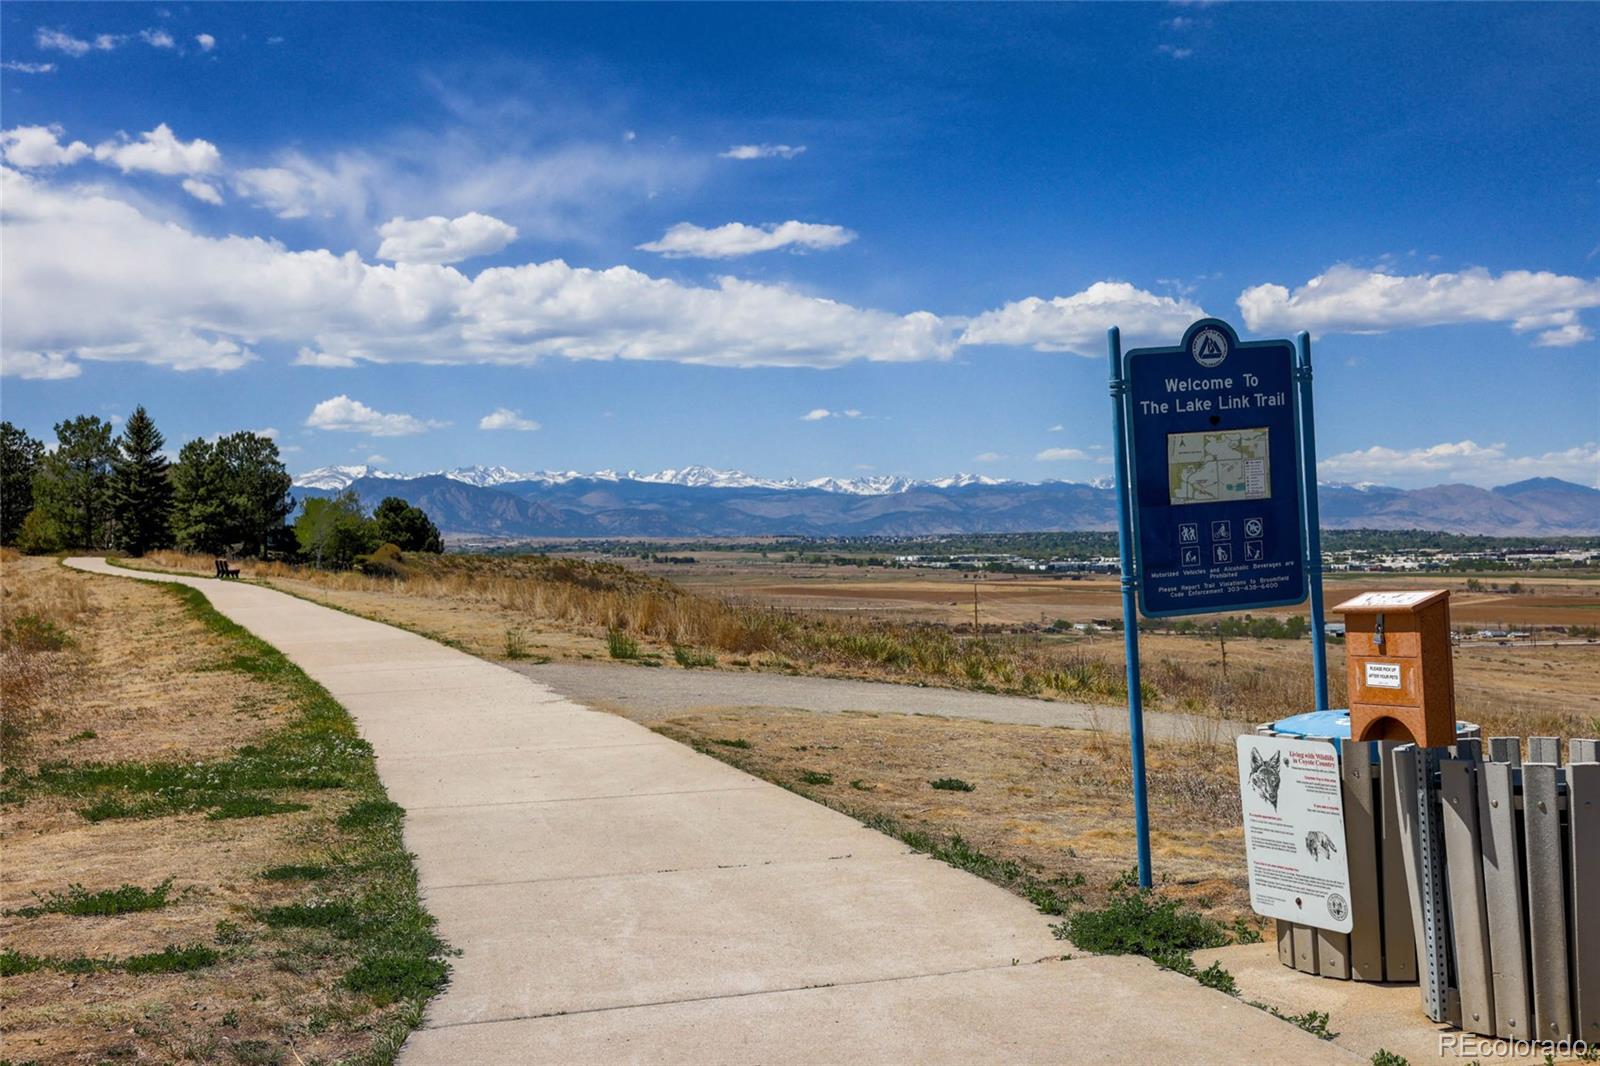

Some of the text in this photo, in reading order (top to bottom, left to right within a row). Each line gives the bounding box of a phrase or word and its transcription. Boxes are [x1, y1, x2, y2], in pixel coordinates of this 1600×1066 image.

[1165, 373, 1259, 392] Welcome To
[1140, 392, 1285, 415] The Lake Link Trail
[1151, 570, 1179, 579] Motorized
[1183, 568, 1206, 576] Vehicles
[1253, 561, 1282, 570] Beverages
[1209, 571, 1238, 579] Prohibited
[1219, 579, 1246, 588] Violations
[1170, 590, 1184, 598] Code
[1289, 751, 1305, 759] Living
[1315, 753, 1335, 761] Wildlife
[1315, 760, 1335, 769] Country
